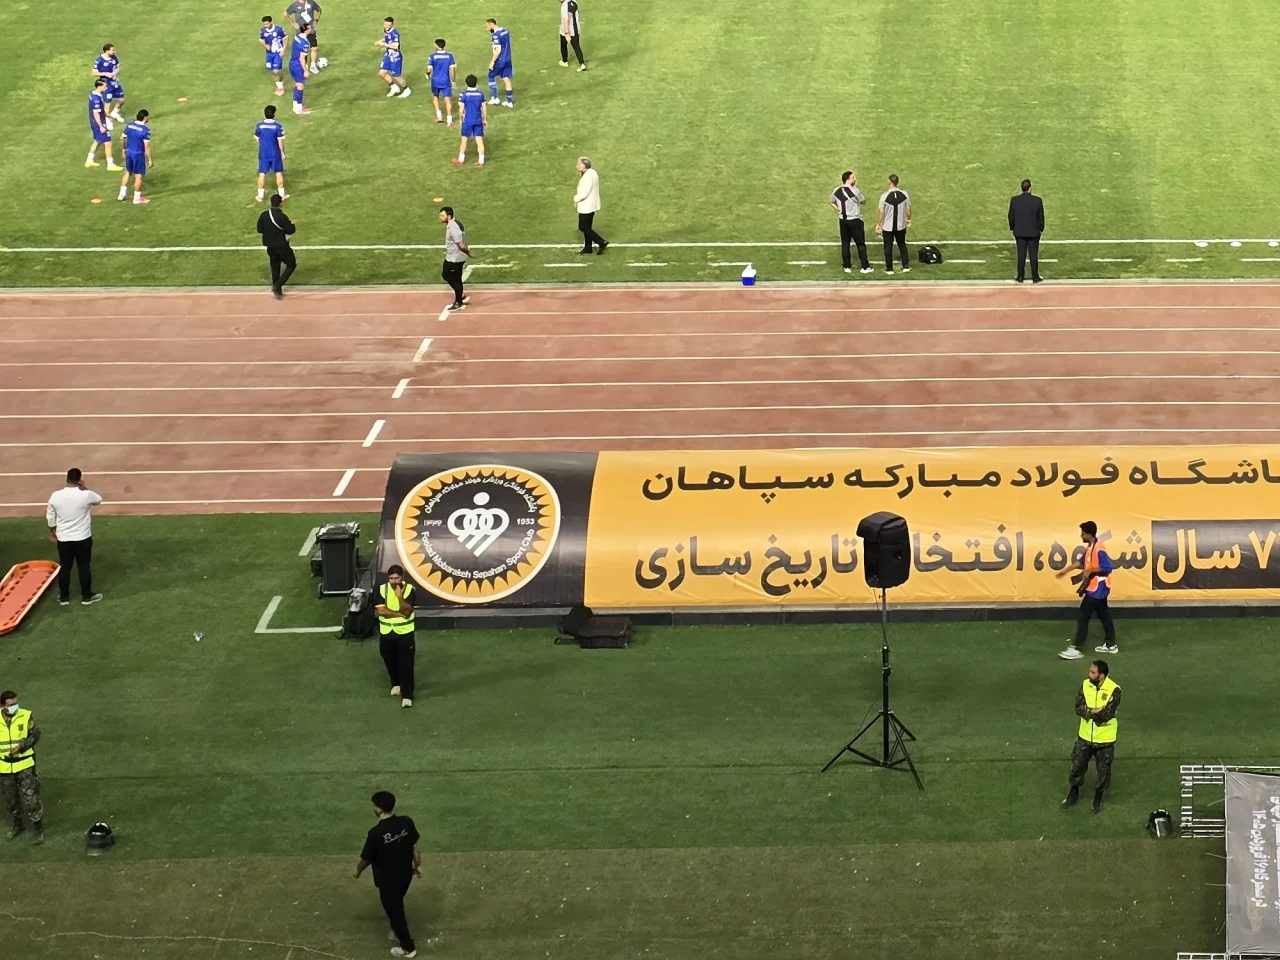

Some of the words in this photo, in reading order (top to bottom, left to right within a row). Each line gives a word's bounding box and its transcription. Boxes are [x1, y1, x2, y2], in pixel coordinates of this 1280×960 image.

[642, 465, 835, 504] سپاهان
[843, 463, 1002, 499] مبارکه
[1010, 456, 1120, 497] فولاد
[516, 517, 535, 525] 1953
[421, 530, 436, 558] Foolad
[431, 553, 472, 579] Mobarakeh
[472, 563, 507, 579] Sepahan
[506, 545, 527, 566] Sport
[521, 528, 535, 547] Club
[635, 535, 753, 591] سازی
[760, 534, 858, 596] تاریخ
[913, 524, 1025, 573] افتخا
[1033, 529, 1149, 586] شوه،
[1156, 528, 1242, 585] سال
